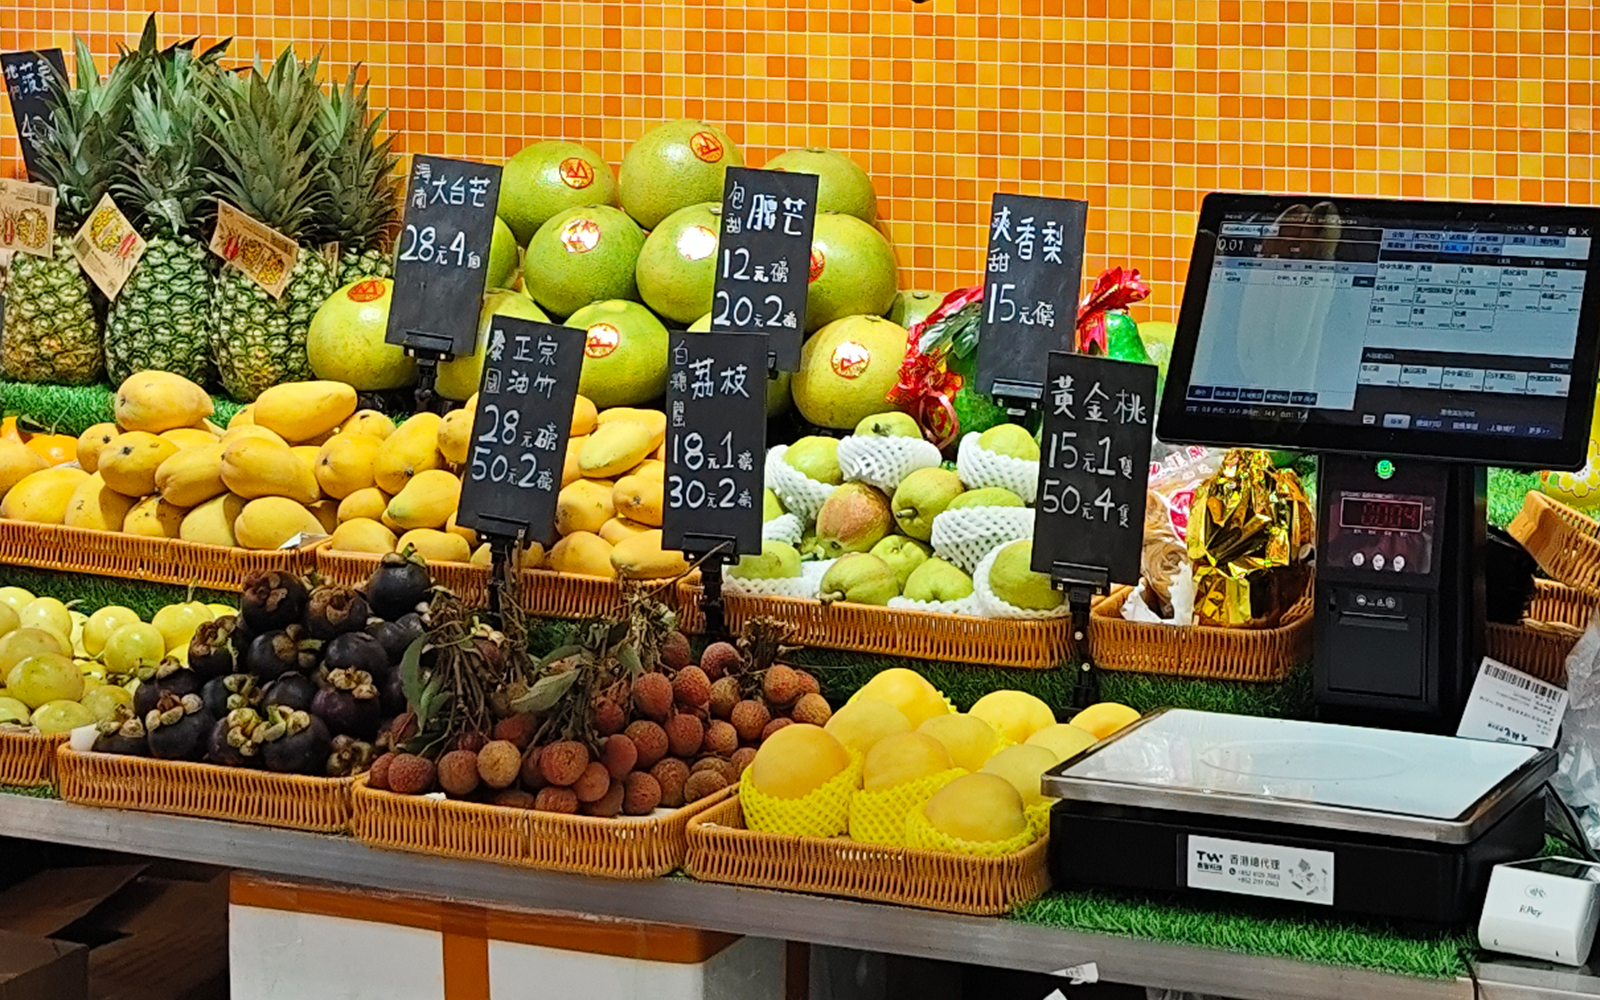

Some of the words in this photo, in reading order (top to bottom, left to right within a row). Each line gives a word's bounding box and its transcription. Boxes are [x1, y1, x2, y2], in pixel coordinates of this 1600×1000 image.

[1230, 854, 1280, 870] 香港總代理
